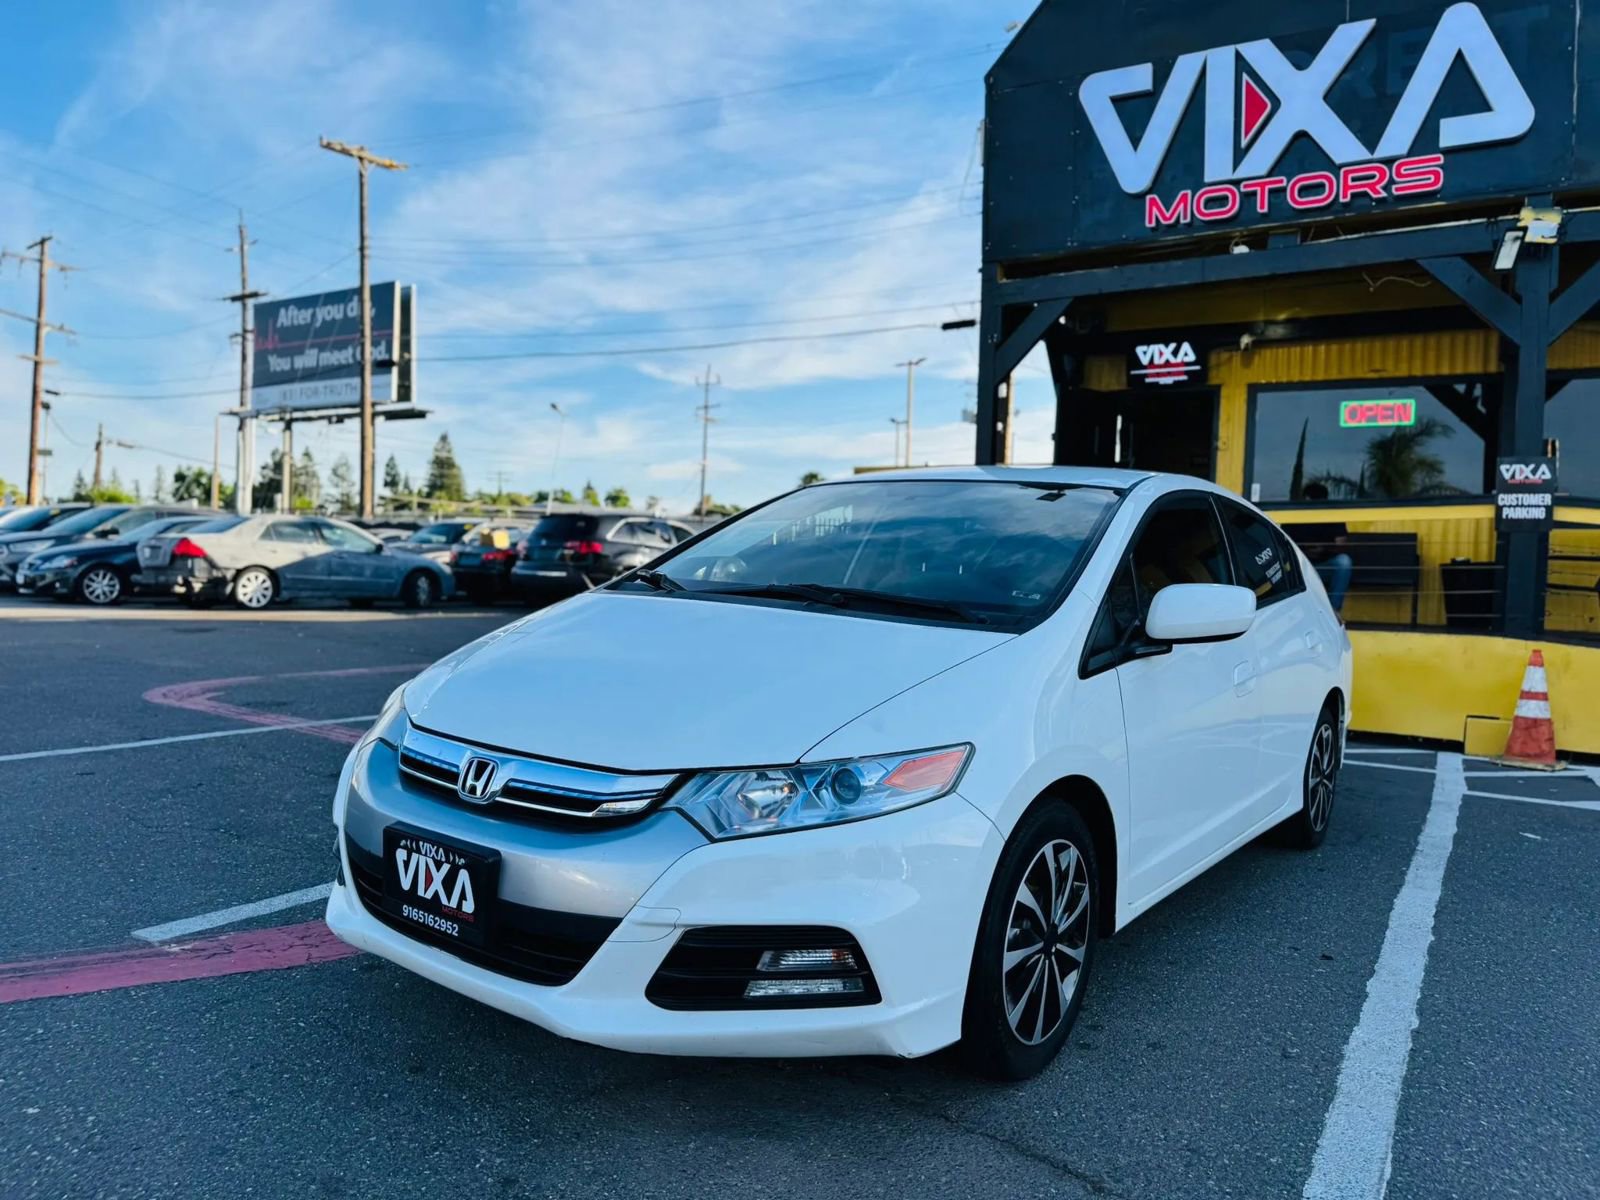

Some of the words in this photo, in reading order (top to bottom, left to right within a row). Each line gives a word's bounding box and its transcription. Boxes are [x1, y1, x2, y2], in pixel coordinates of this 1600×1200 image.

[1078, 2, 1536, 194] VIXA
[1144, 153, 1444, 228] MOTORS
[276, 304, 312, 328] After
[315, 300, 345, 328] you
[268, 353, 291, 373] You
[293, 348, 319, 370] will
[319, 346, 355, 367] meet
[1135, 341, 1197, 366] VIXA
[1344, 402, 1412, 425] OPEN
[1499, 463, 1552, 480] VIXA
[1497, 493, 1552, 506] CUSTOMER
[1502, 506, 1546, 519] PARKING
[419, 840, 446, 862] VIXA
[395, 848, 475, 914] VIXA
[402, 904, 459, 937] 9165162952
